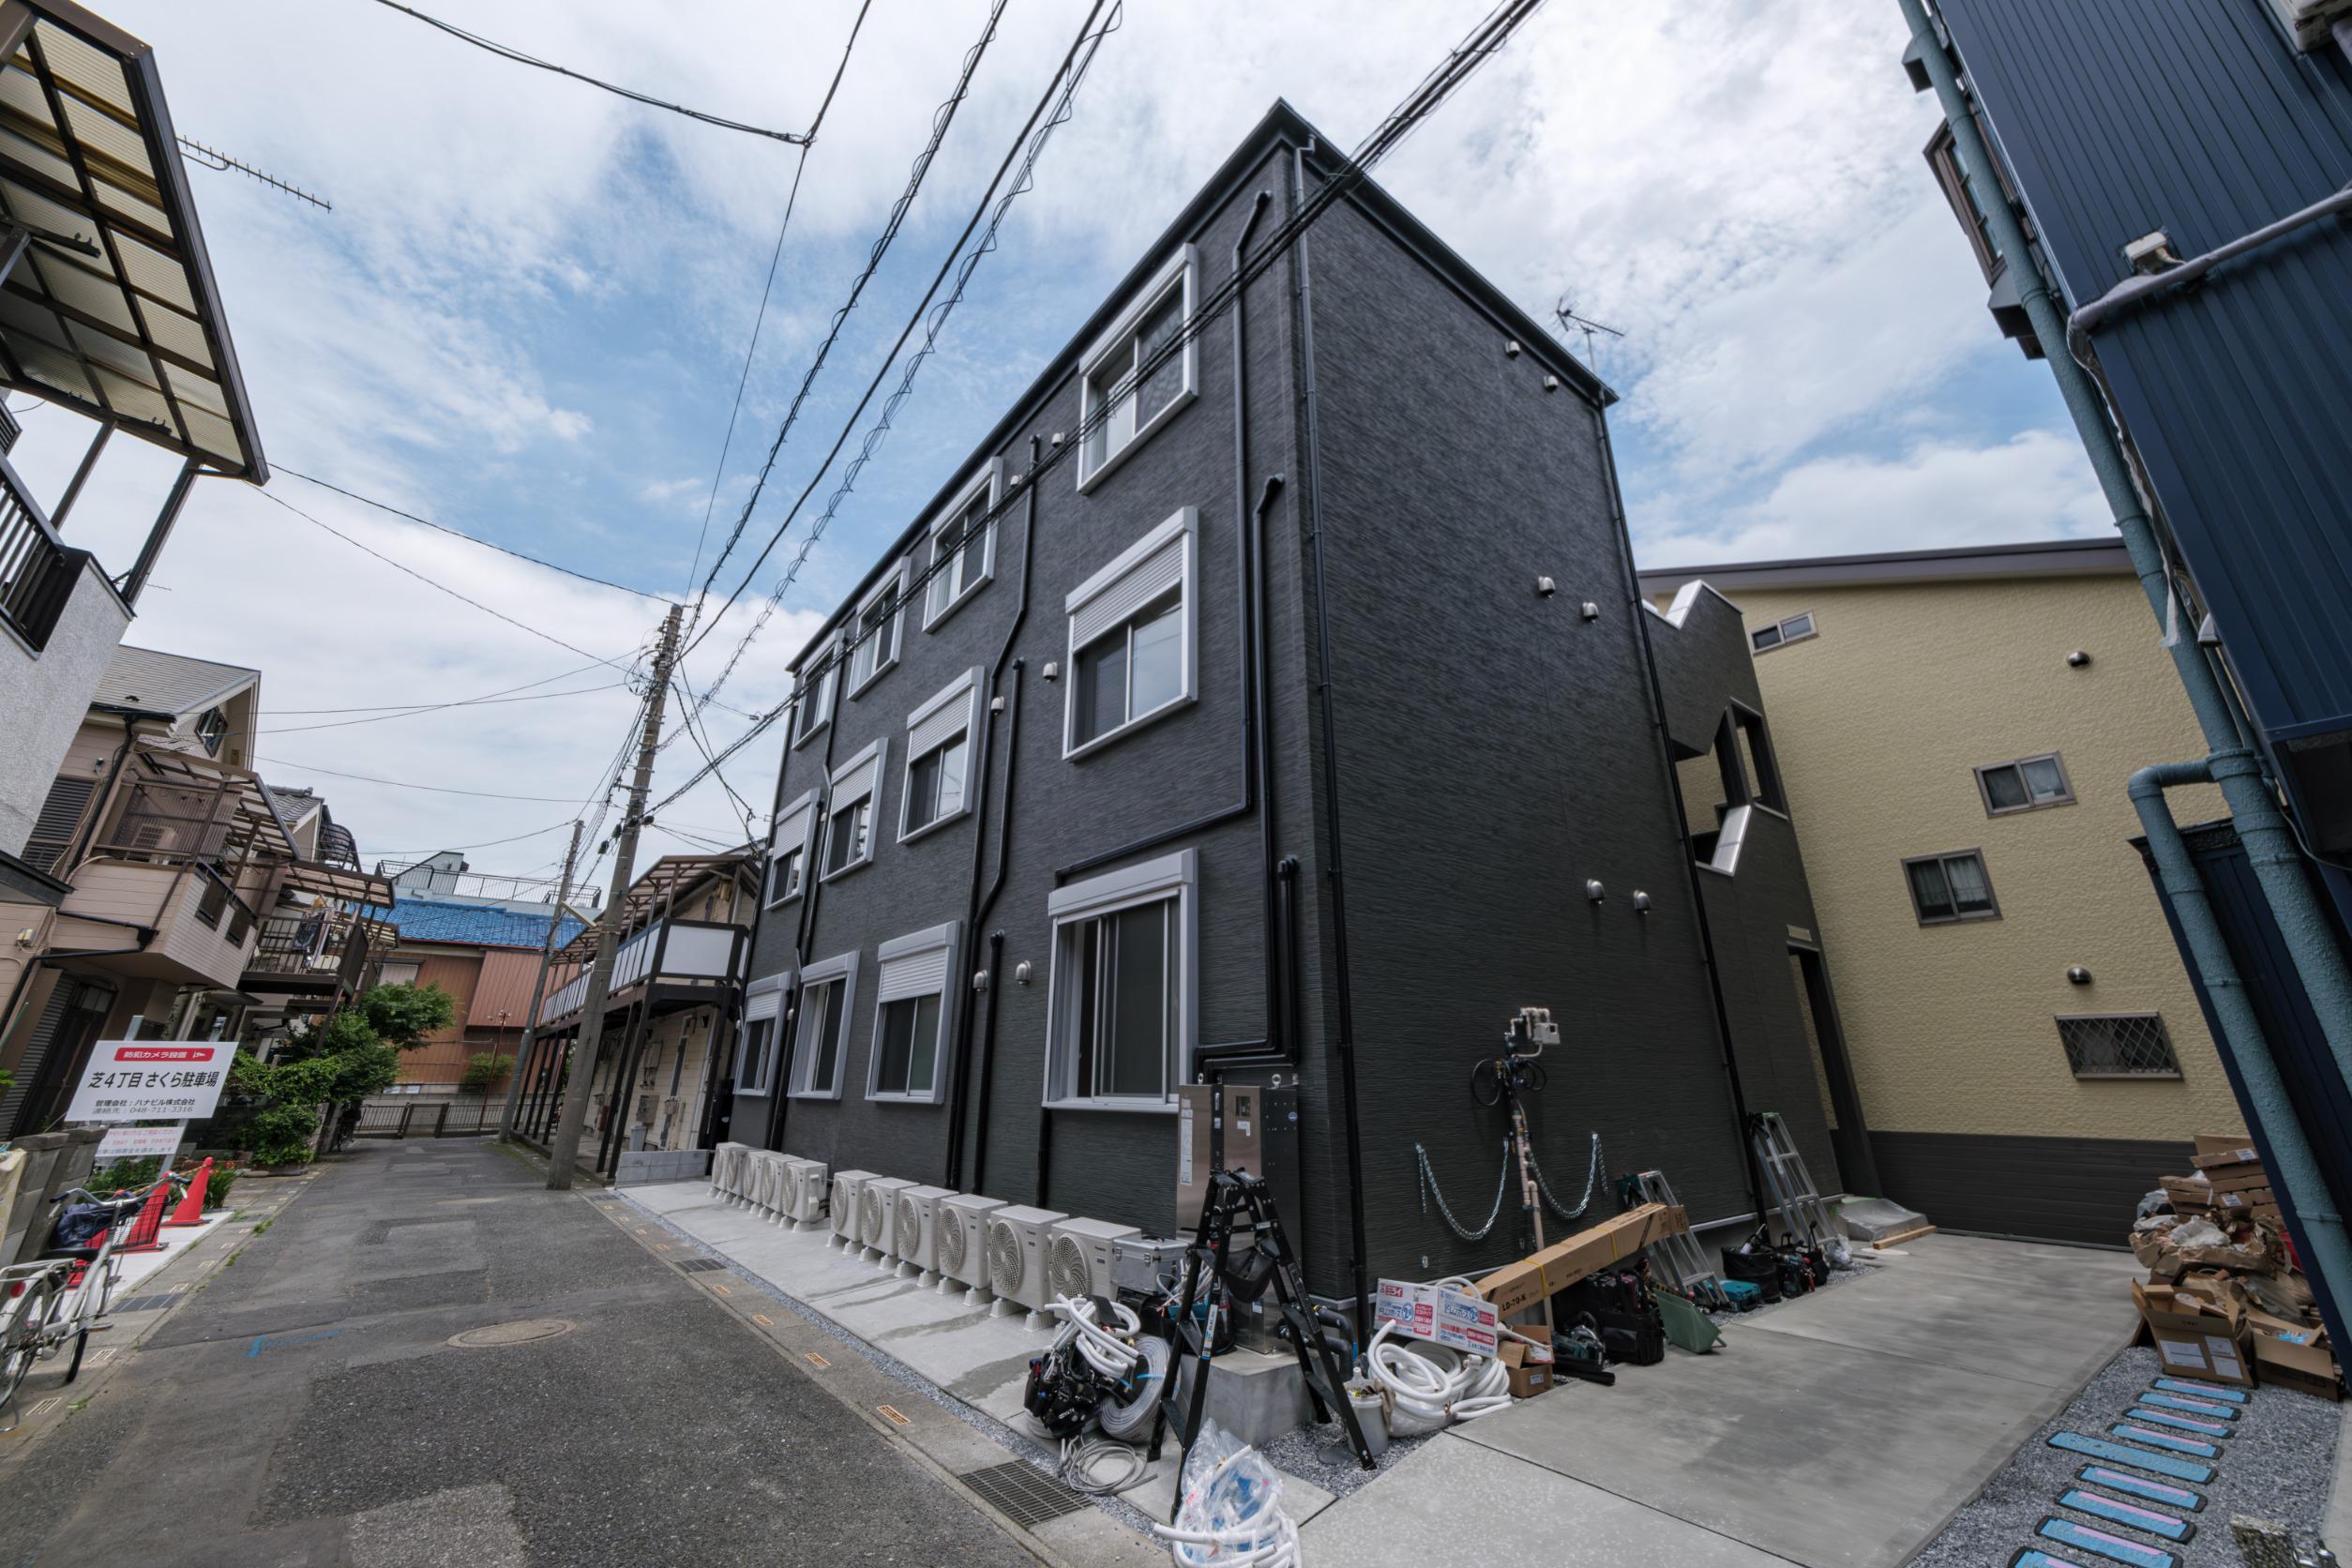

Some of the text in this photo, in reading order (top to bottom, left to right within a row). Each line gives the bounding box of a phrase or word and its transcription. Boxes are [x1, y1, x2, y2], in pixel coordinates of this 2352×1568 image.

[123, 1050, 188, 1059] 防犯カメラ設置
[145, 1071, 220, 1088] さくら駐車場
